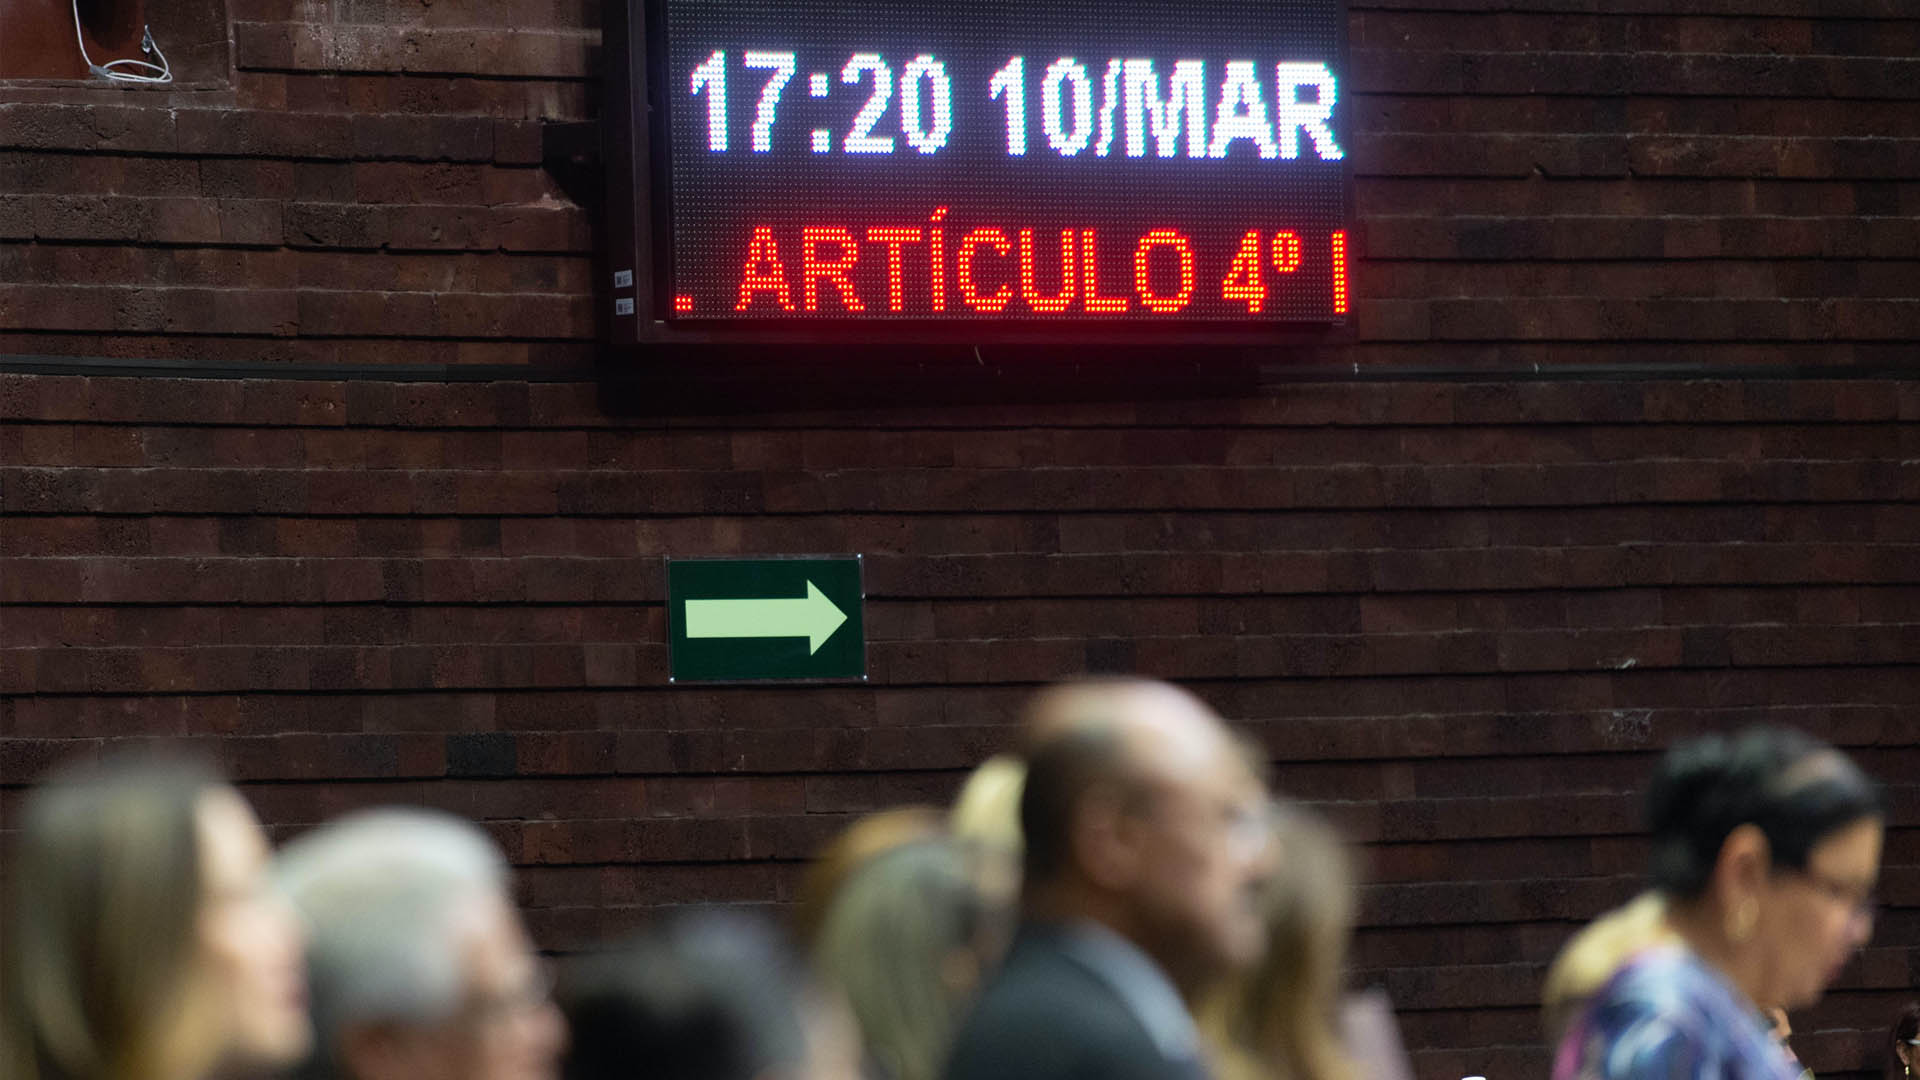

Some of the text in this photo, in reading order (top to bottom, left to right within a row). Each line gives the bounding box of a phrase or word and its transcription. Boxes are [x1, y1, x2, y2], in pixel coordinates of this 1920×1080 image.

[690, 49, 1343, 160] 17:20 10/MAR
[734, 204, 1197, 314] ARTÍCULO
